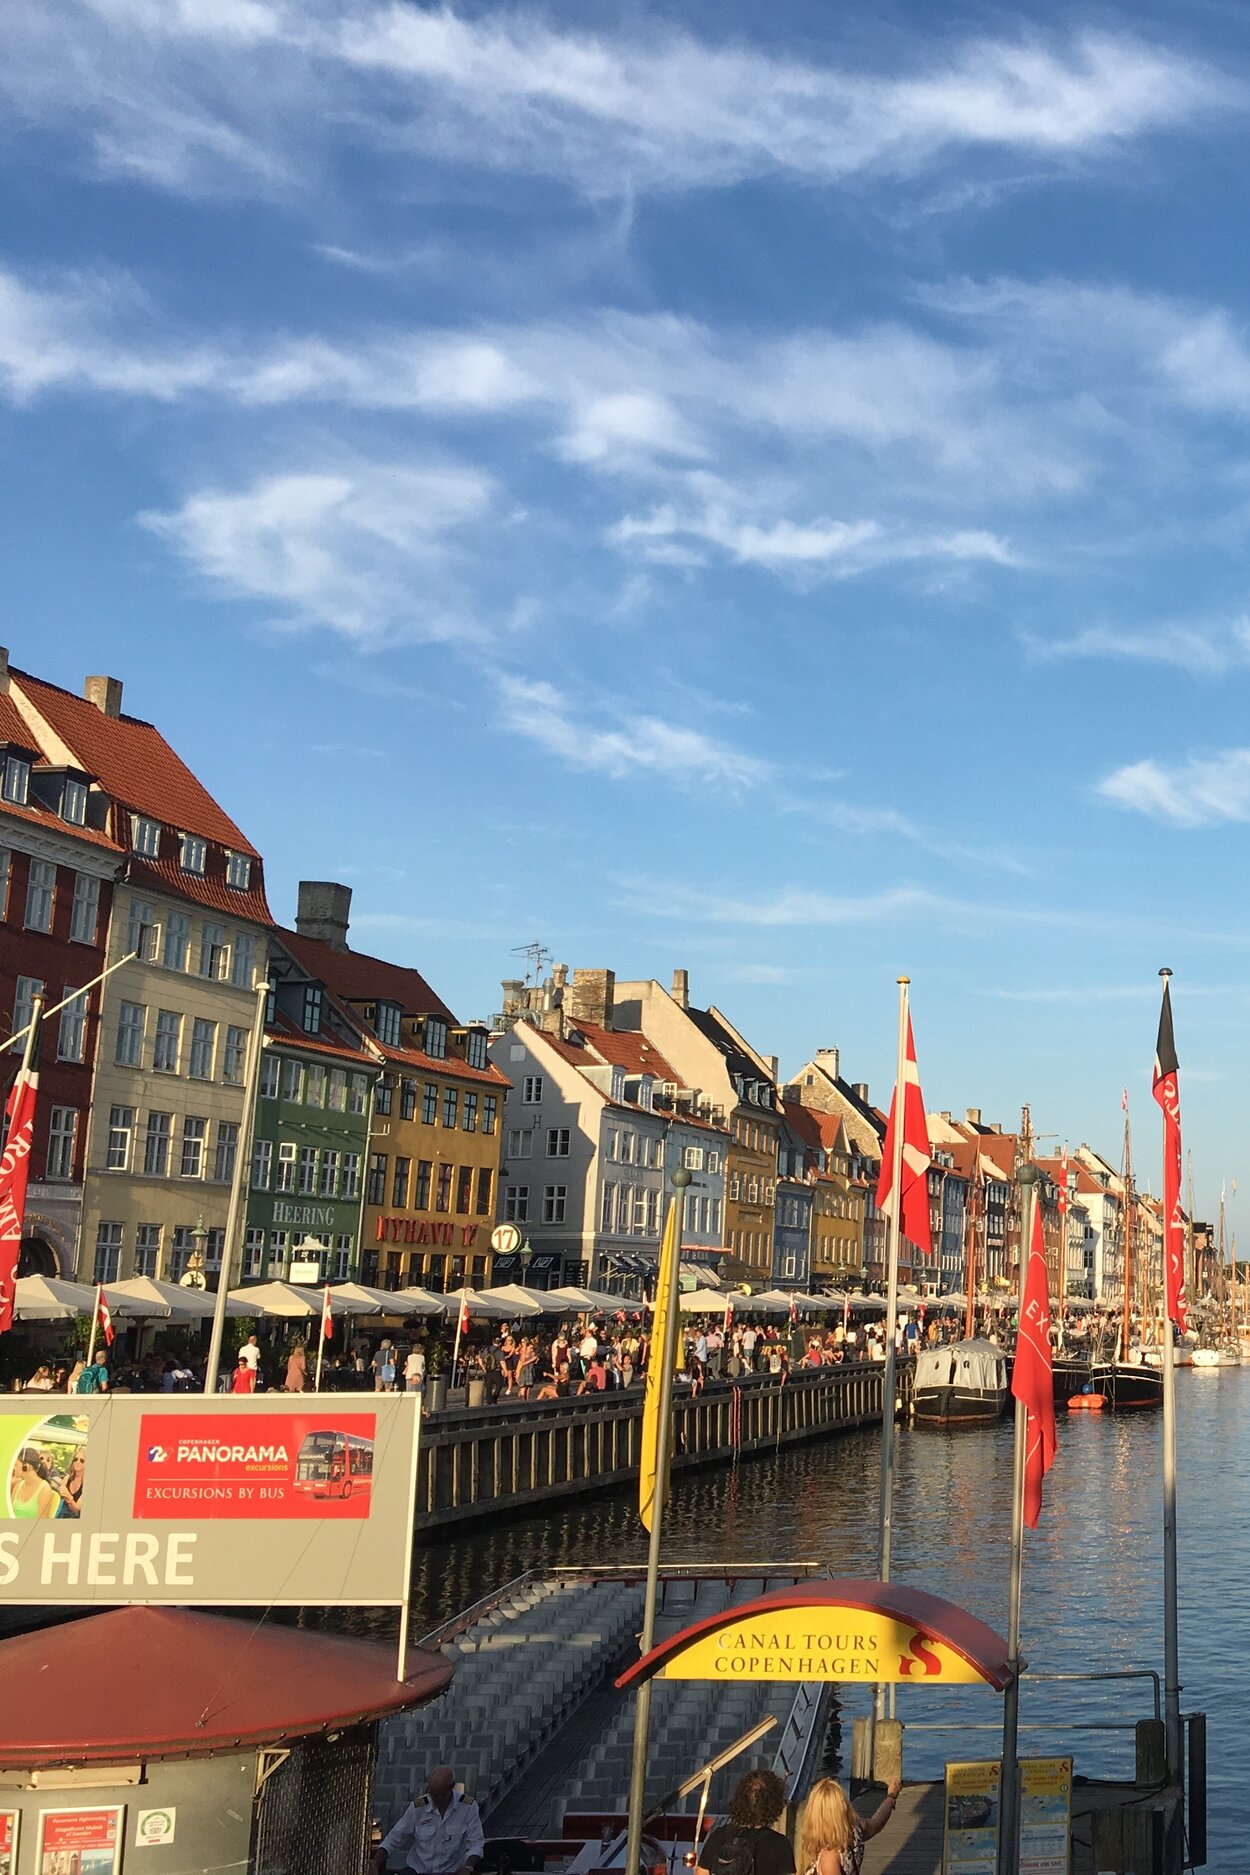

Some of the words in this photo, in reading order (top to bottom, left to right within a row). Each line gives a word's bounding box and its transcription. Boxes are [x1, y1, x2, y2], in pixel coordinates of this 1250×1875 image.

[272, 1201, 335, 1226] HEERING
[462, 1223, 479, 1248] 17
[494, 1229, 514, 1250] 17
[177, 1446, 288, 1463] PANORAMA
[245, 1463, 288, 1472] excursions
[146, 1488, 232, 1500] EXCURSIONS
[238, 1488, 254, 1499] BY
[259, 1487, 285, 1499] BUS
[40, 1532, 197, 1586] HERE
[718, 1633, 796, 1650] CANAL
[802, 1633, 878, 1651] TOURS
[714, 1656, 881, 1675] COPENHAGEN
